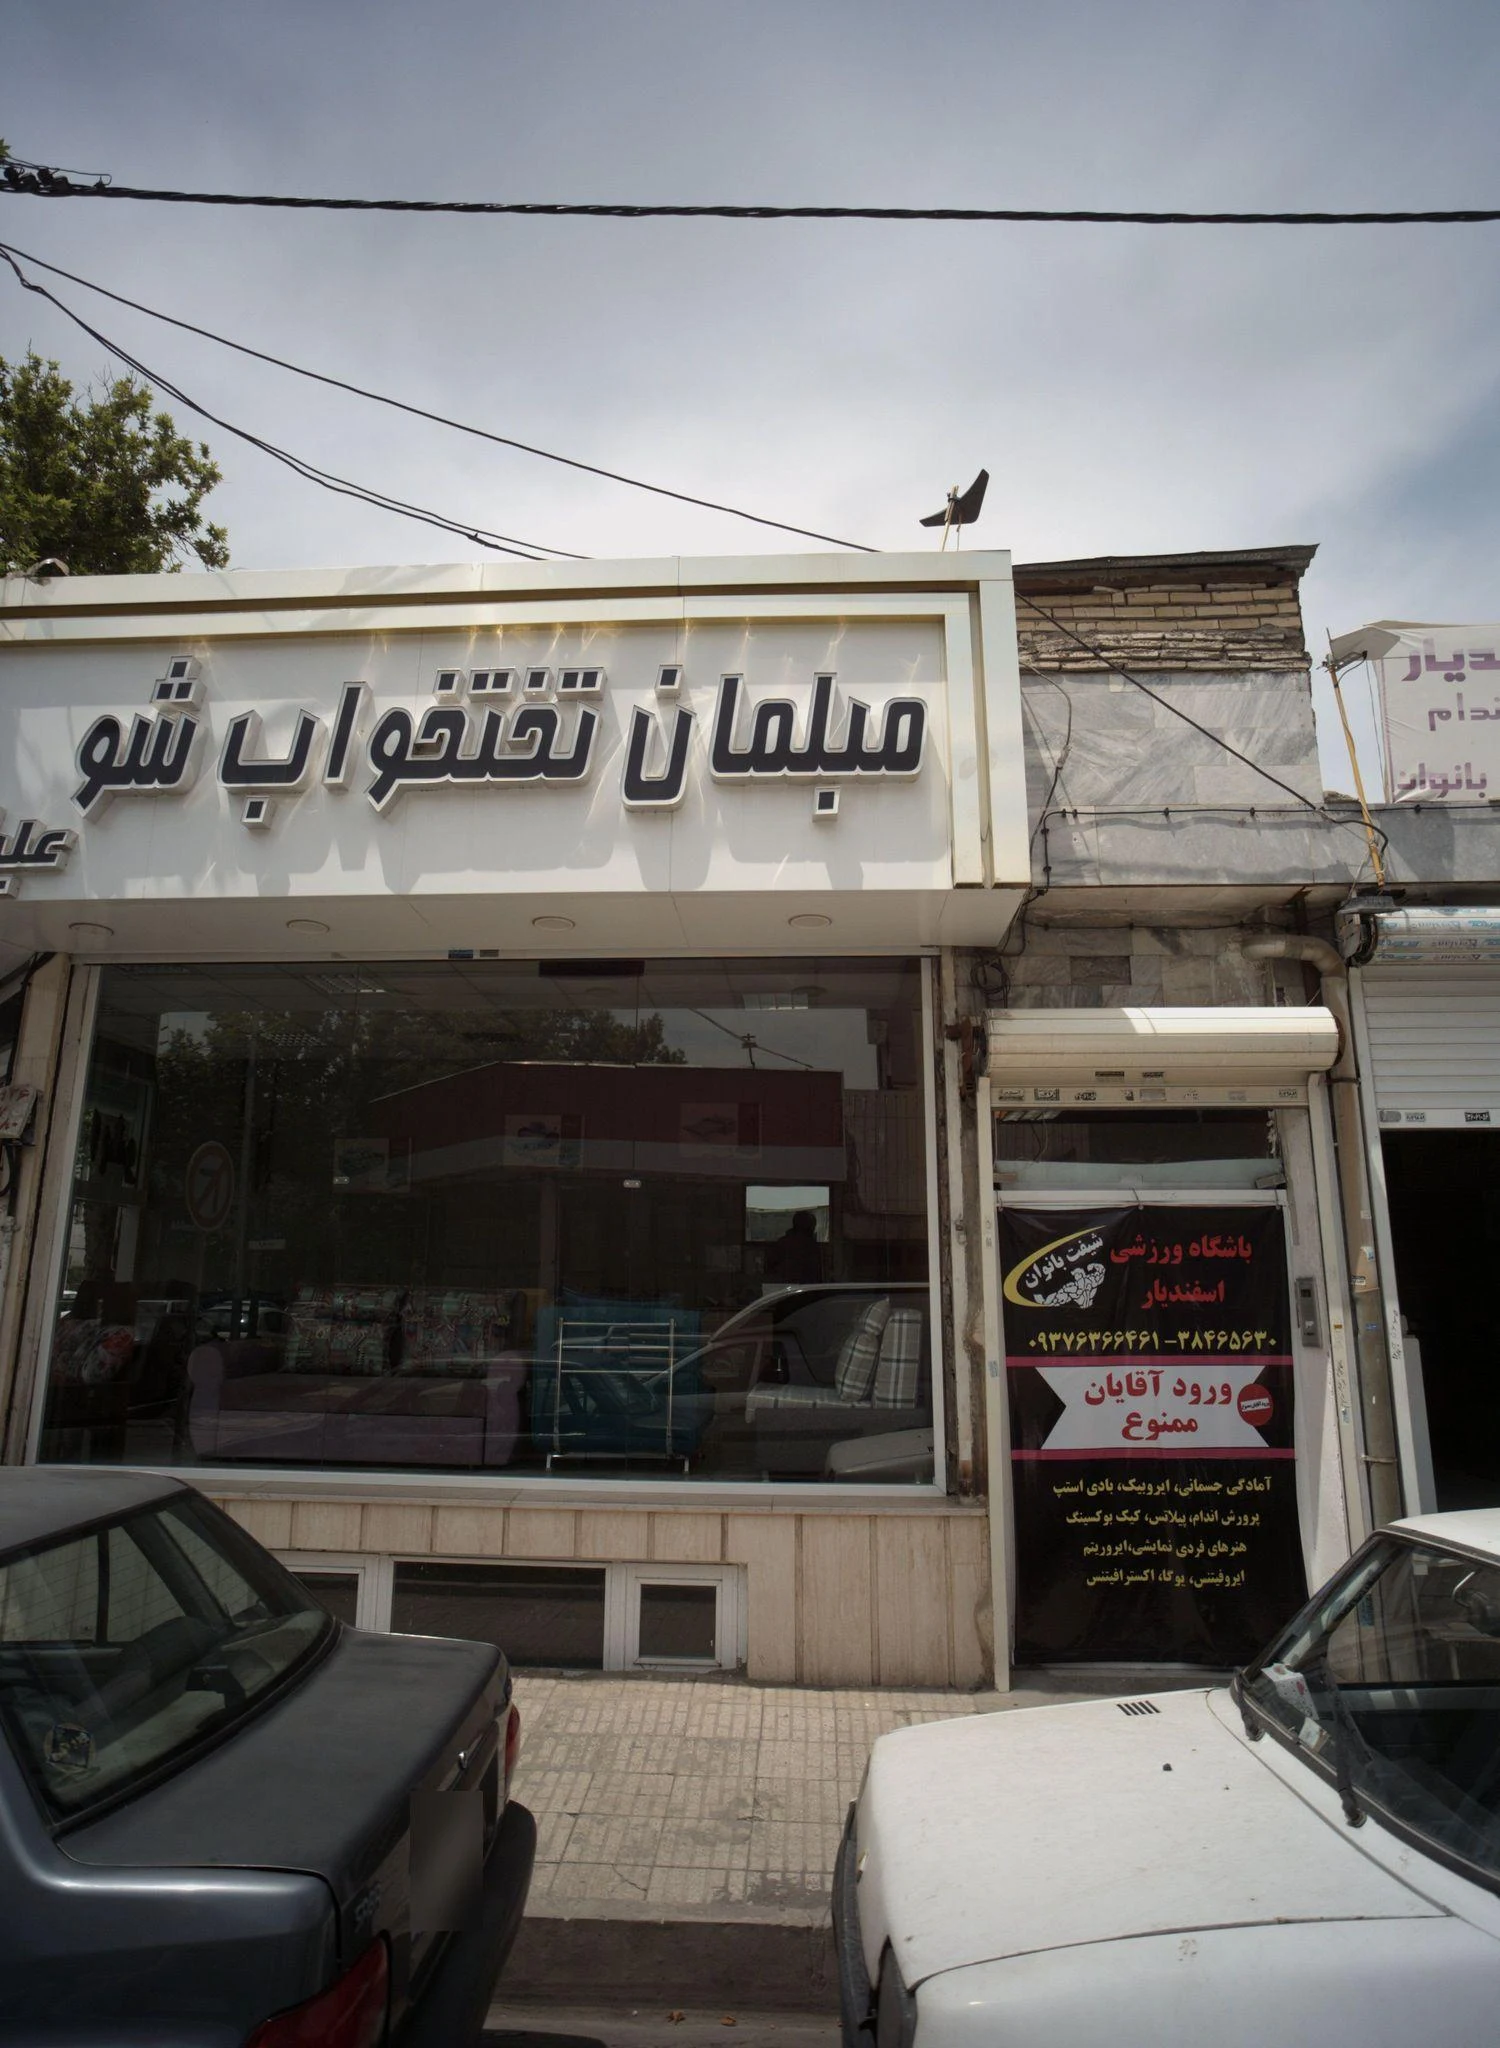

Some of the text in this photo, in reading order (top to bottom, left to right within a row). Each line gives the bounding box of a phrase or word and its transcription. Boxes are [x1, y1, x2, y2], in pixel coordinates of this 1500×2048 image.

[1401, 637, 1500, 682] دیار
[622, 664, 928, 822] مبلمان
[1024, 1231, 1105, 1289] شیفت بانوان
[1110, 1232, 1253, 1265] باشگاه ورزشی
[1141, 1279, 1225, 1309] اسفندیار
[1084, 1369, 1233, 1405] ورود آقایان
[1121, 1410, 1199, 1441] ممنوع
[1053, 1478, 1084, 1498] استپ
[1086, 1478, 1114, 1496] بادی
[1226, 1476, 1272, 1496] آمادگی
[1065, 1509, 1114, 1526] بوکسینگ
[1115, 1509, 1141, 1523] کیک
[1221, 1511, 1260, 1526] پرورش
[1175, 1541, 1205, 1558] فردی
